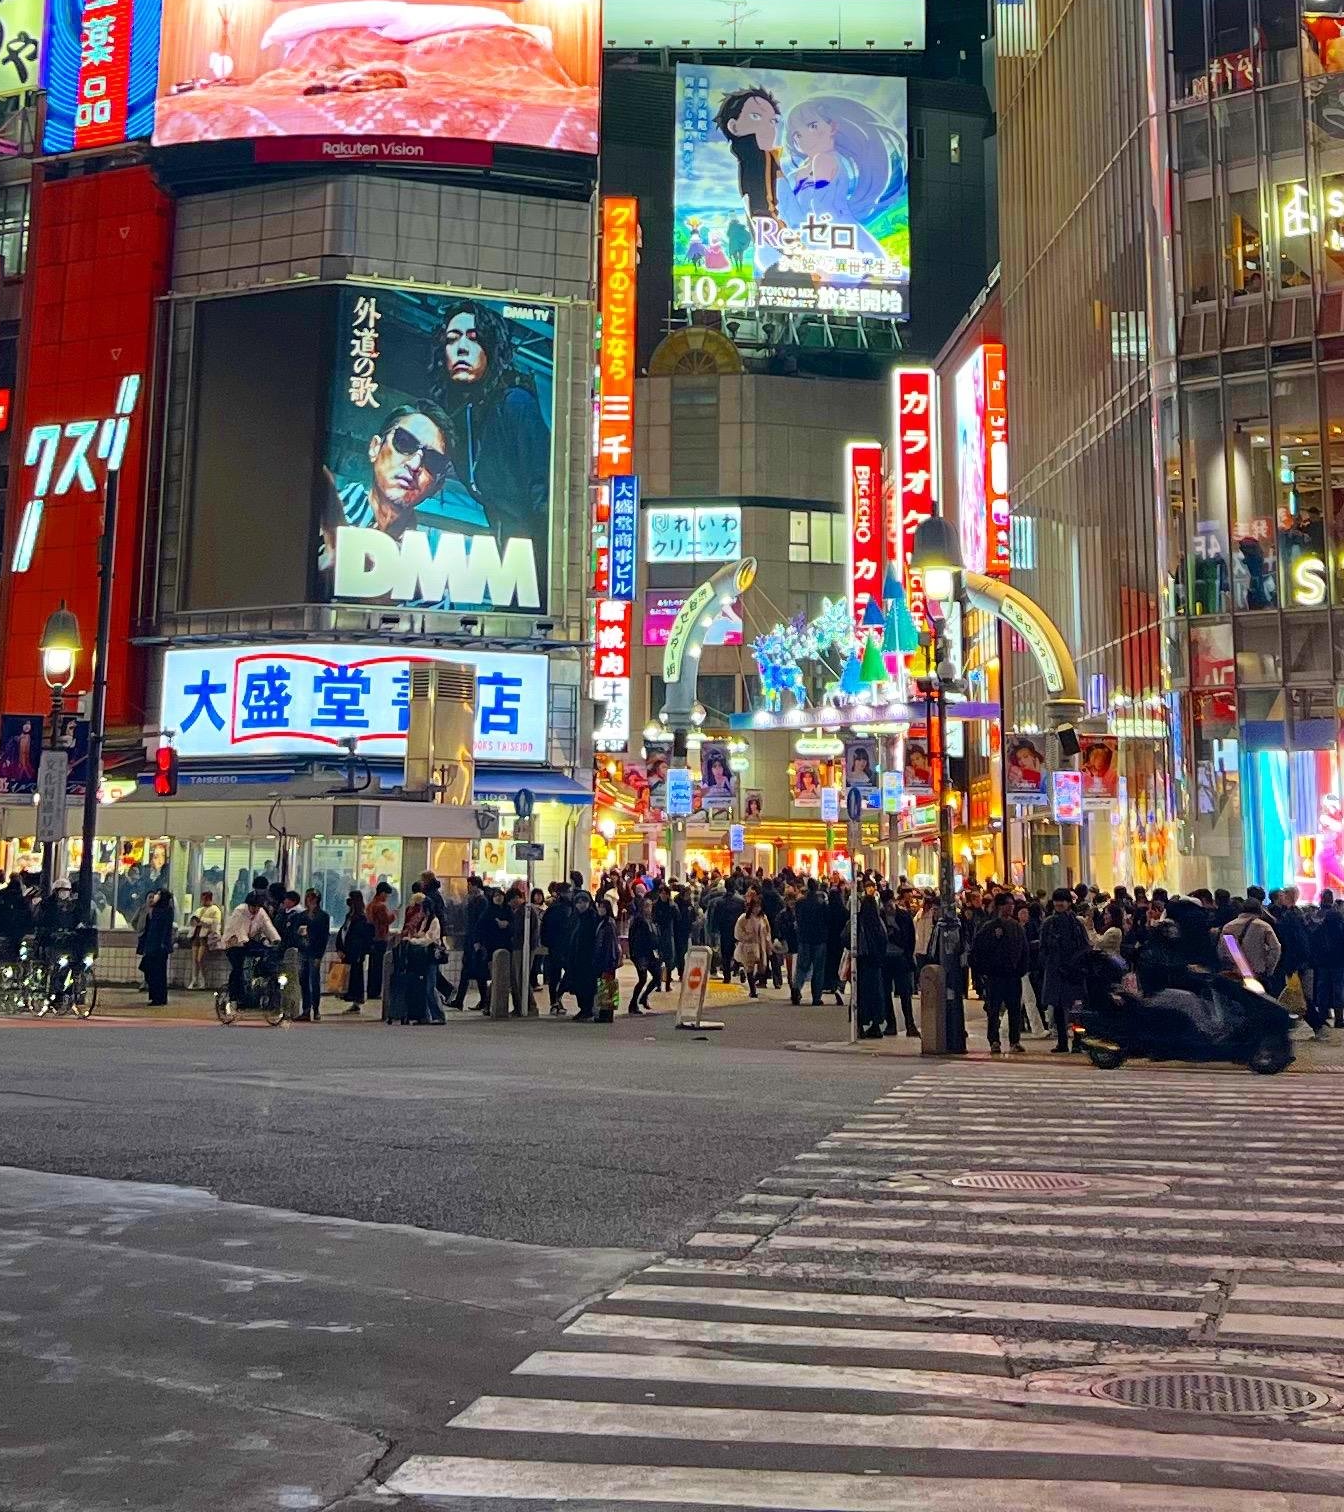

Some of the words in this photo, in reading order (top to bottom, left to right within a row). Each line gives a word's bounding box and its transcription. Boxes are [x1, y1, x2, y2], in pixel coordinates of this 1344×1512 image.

[322, 141, 379, 158] Rakuten
[383, 142, 424, 157] Vision
[608, 207, 631, 381] クスリのことなら
[349, 296, 381, 408] 外道の歌
[614, 482, 634, 596] 大盛堂商事ビル
[674, 513, 738, 534] れいわ
[856, 499, 871, 543] ECHO
[334, 525, 540, 608] DMM
[653, 539, 737, 557] クリニック
[190, 775, 238, 784] TAISEIDO
